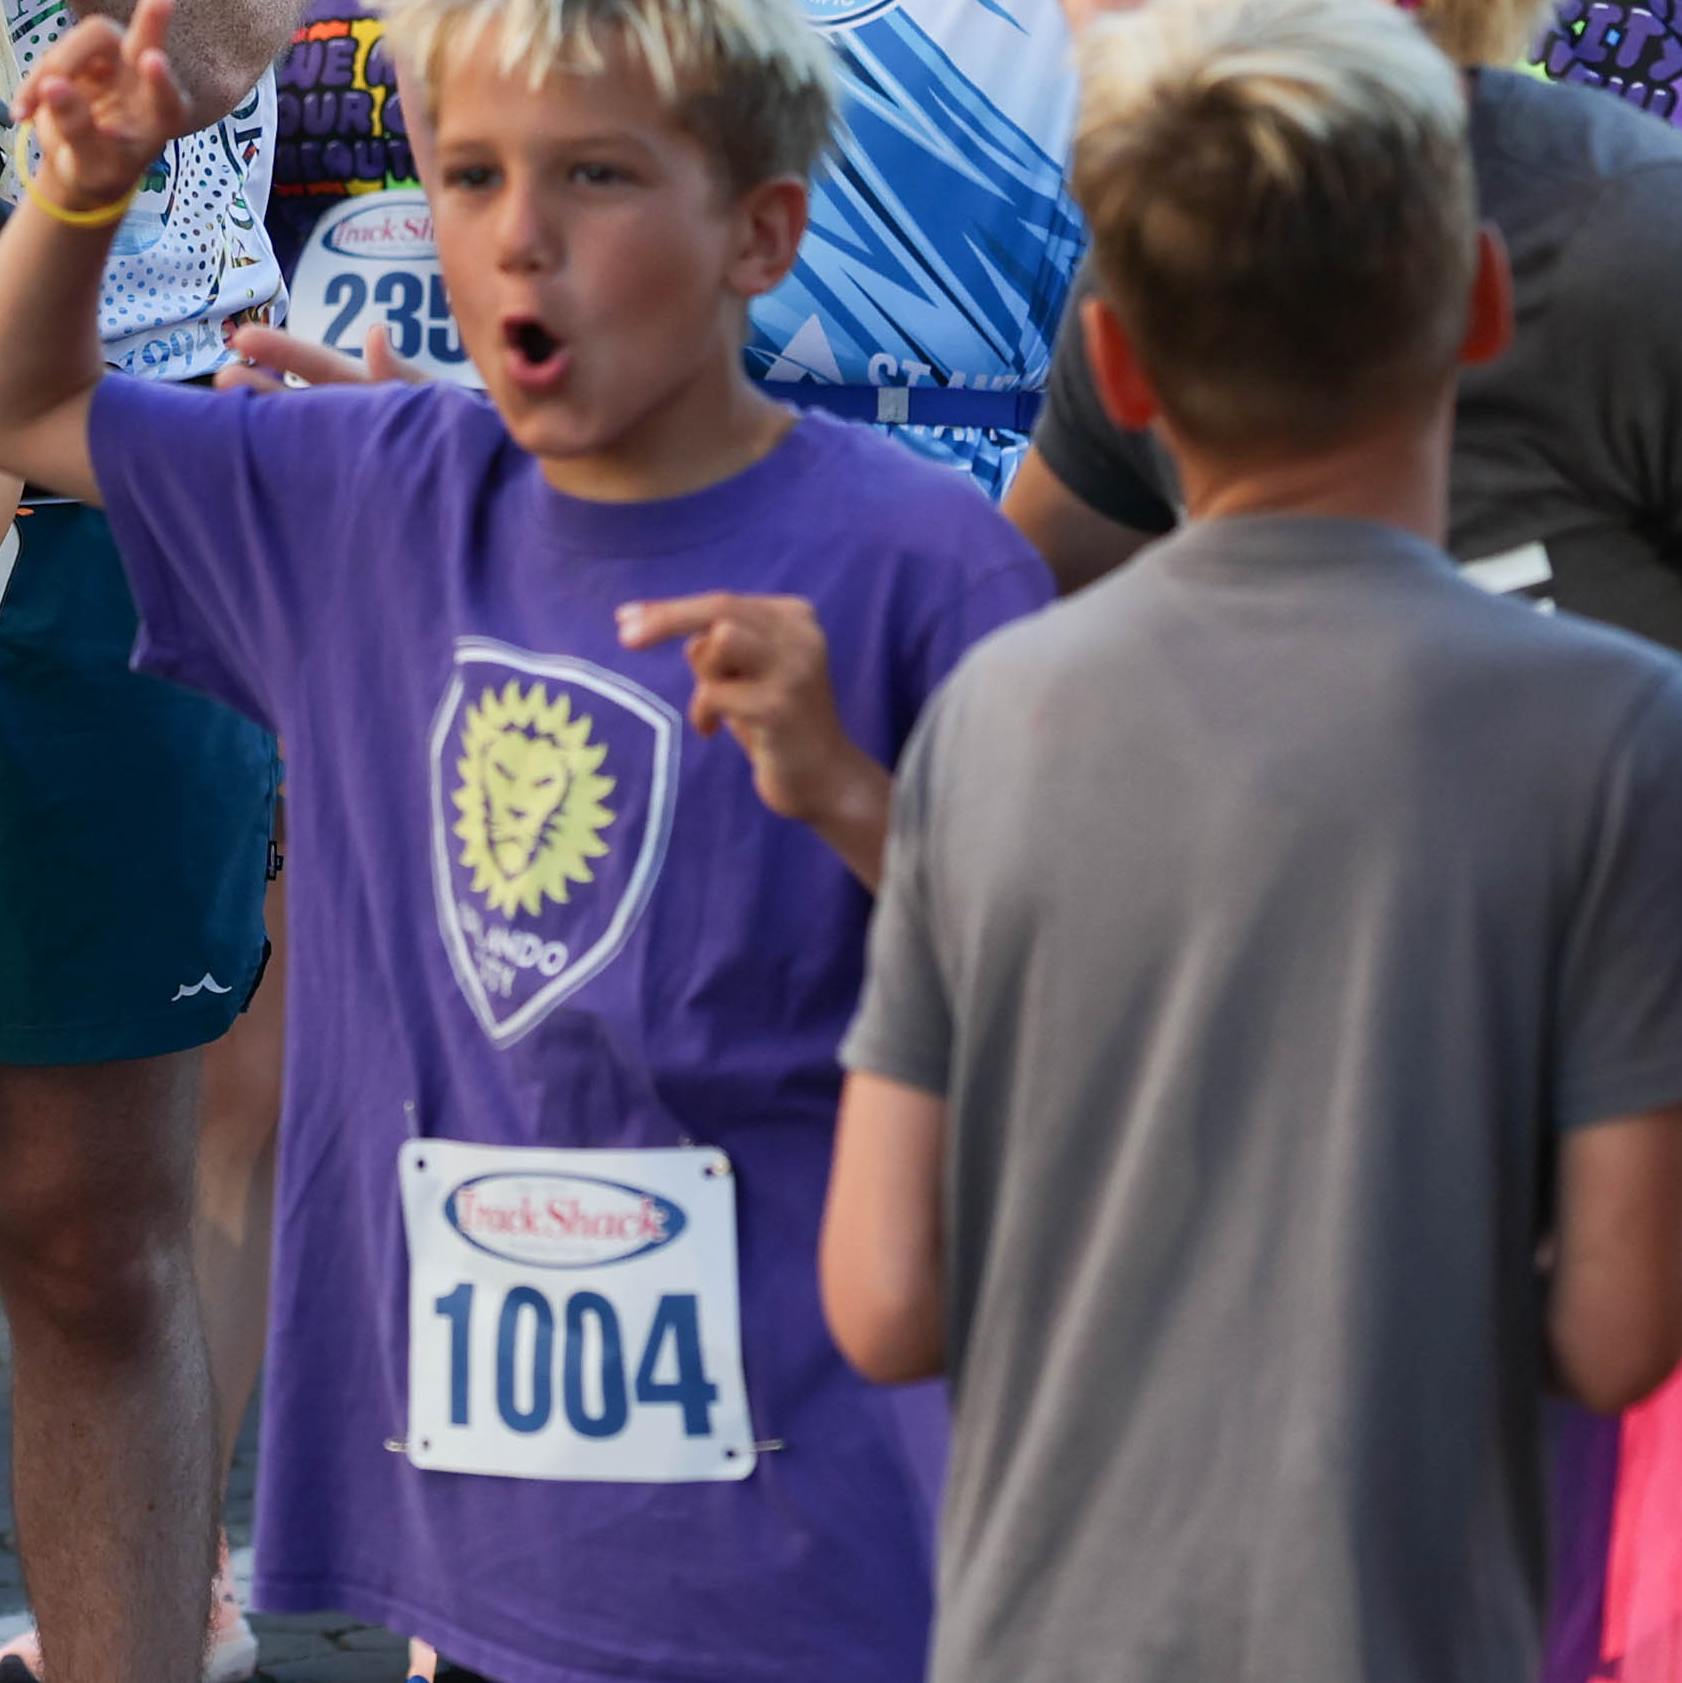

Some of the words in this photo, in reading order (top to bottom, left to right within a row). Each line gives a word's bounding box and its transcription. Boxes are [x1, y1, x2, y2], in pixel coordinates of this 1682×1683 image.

[322, 271, 470, 364] 235
[545, 1196, 667, 1242] Shack
[434, 1282, 718, 1437] 1004
